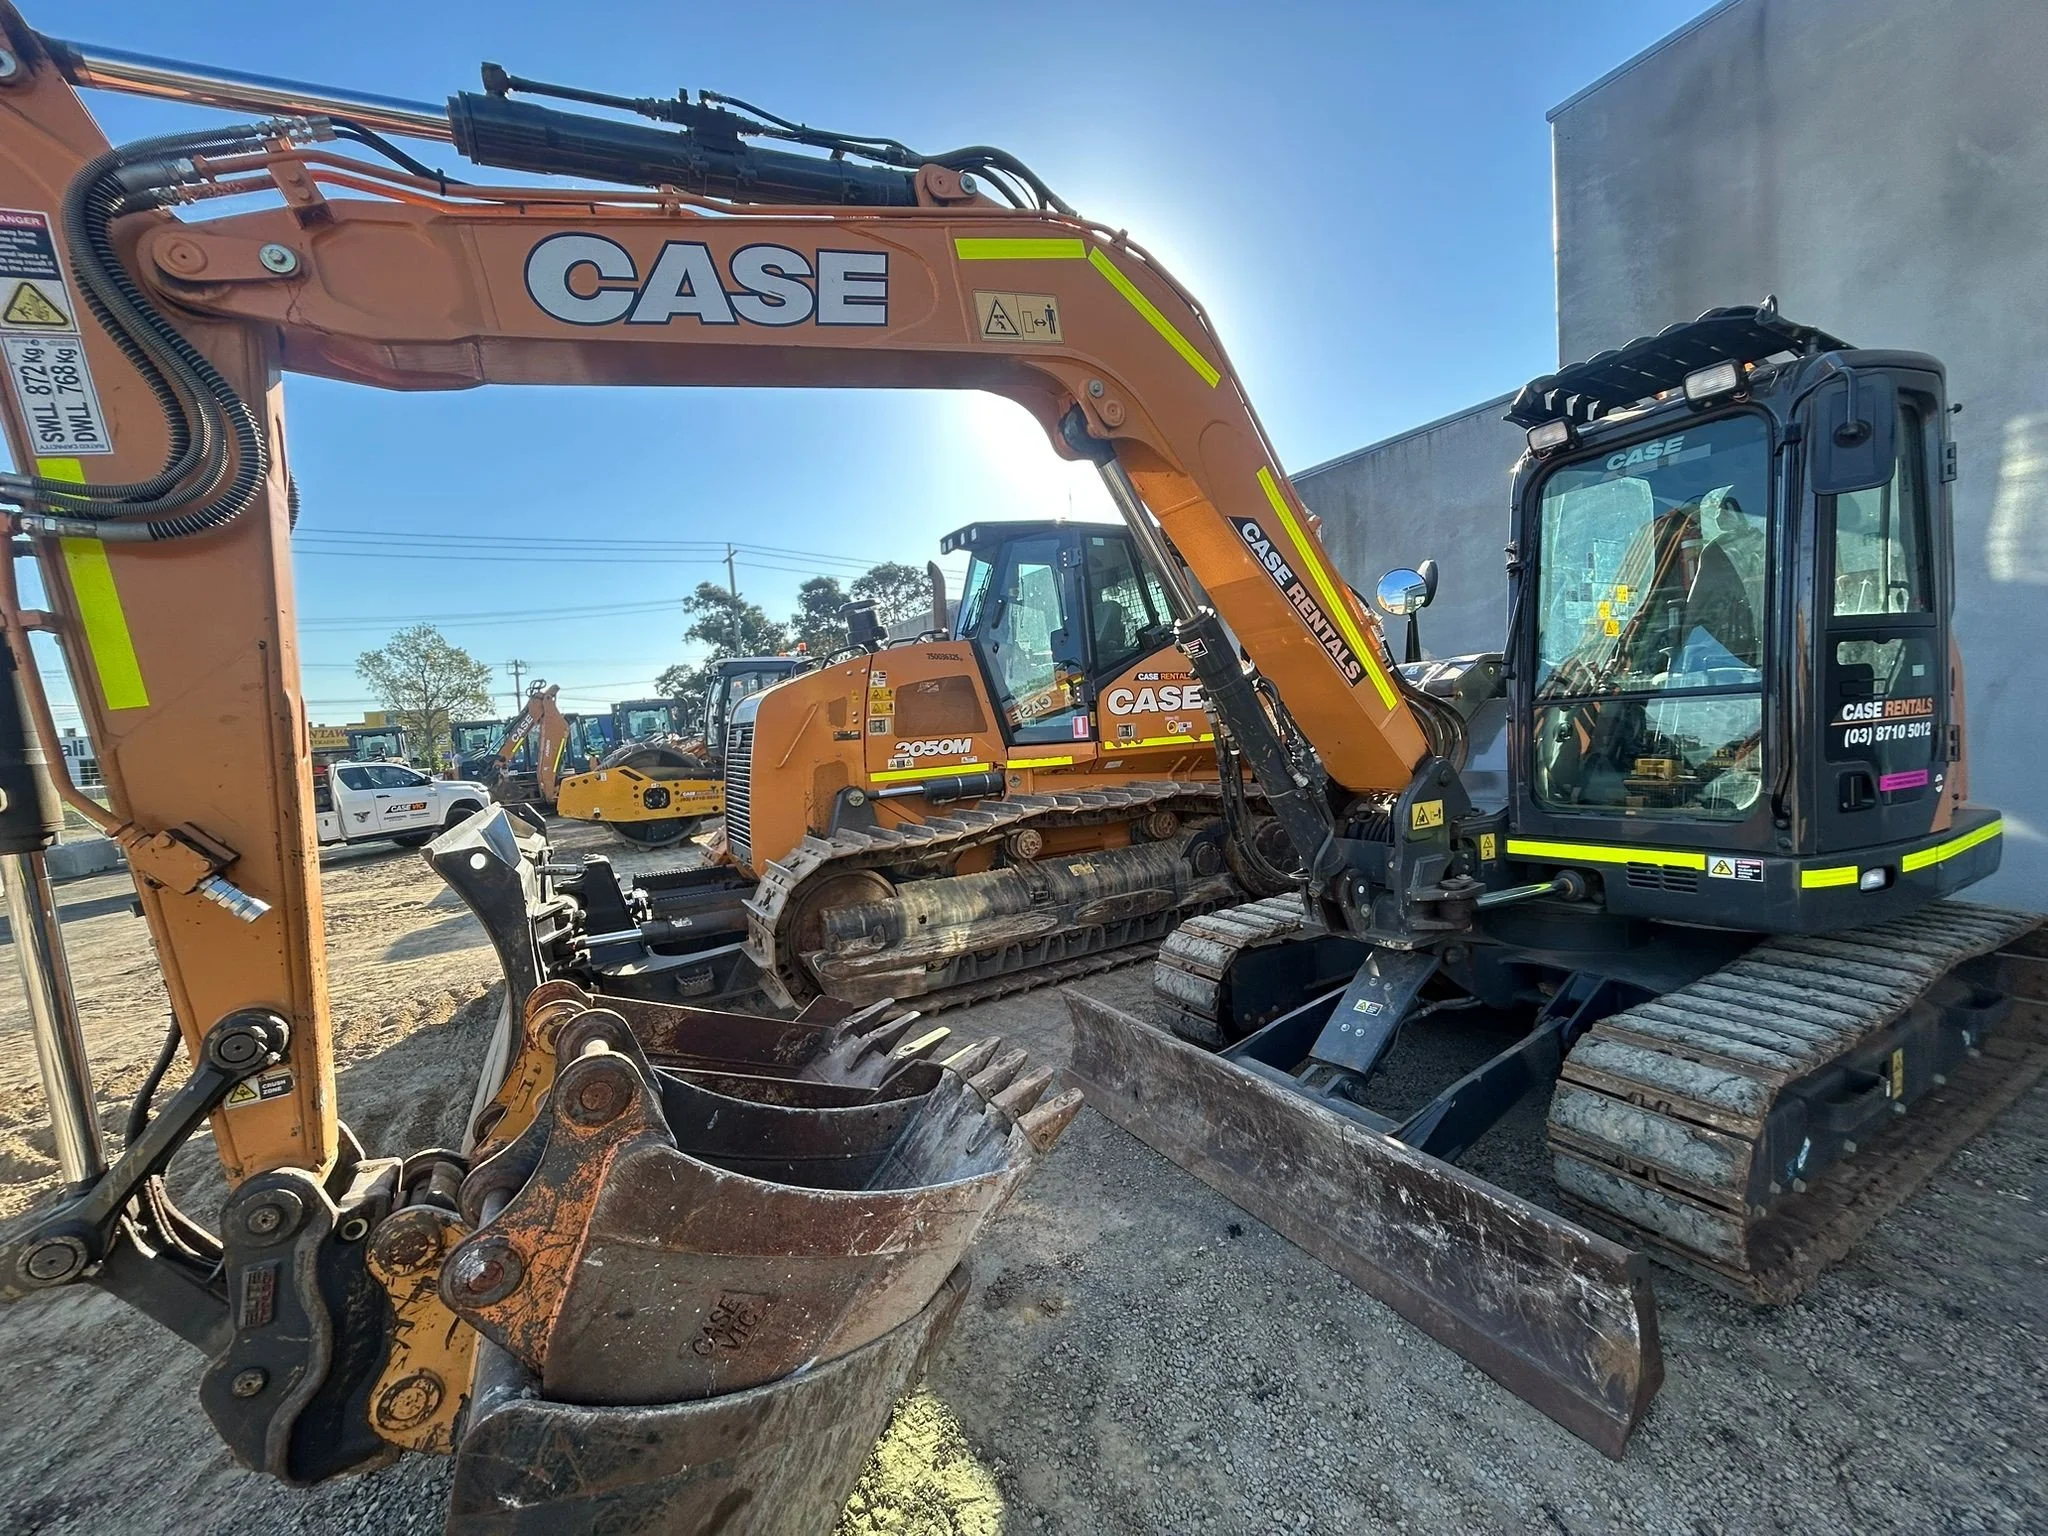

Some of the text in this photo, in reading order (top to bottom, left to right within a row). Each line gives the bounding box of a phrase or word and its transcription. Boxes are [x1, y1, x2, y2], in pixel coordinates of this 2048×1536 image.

[524, 231, 888, 326] CASE
[22, 347, 45, 364] Kg
[54, 348, 77, 364] Kg
[19, 365, 52, 396] 872
[51, 365, 84, 395] 768
[33, 402, 65, 443] SWLL
[66, 401, 98, 443] DWLL
[1606, 435, 1685, 471] CASE
[1241, 522, 1361, 680] CASE RENTALS
[1137, 672, 1191, 681] CASE RENTAL
[1107, 684, 1203, 716] CASE
[1842, 697, 1933, 721] CASE RENTALS
[511, 713, 534, 743] CASE
[1844, 721, 1931, 748] (03) 8710 5012
[893, 737, 973, 759] 2050M
[262, 1079, 286, 1089] CRUSH
[262, 1086, 282, 1095] ZONE
[692, 1294, 741, 1356] CASE
[720, 1310, 758, 1350] VIC
